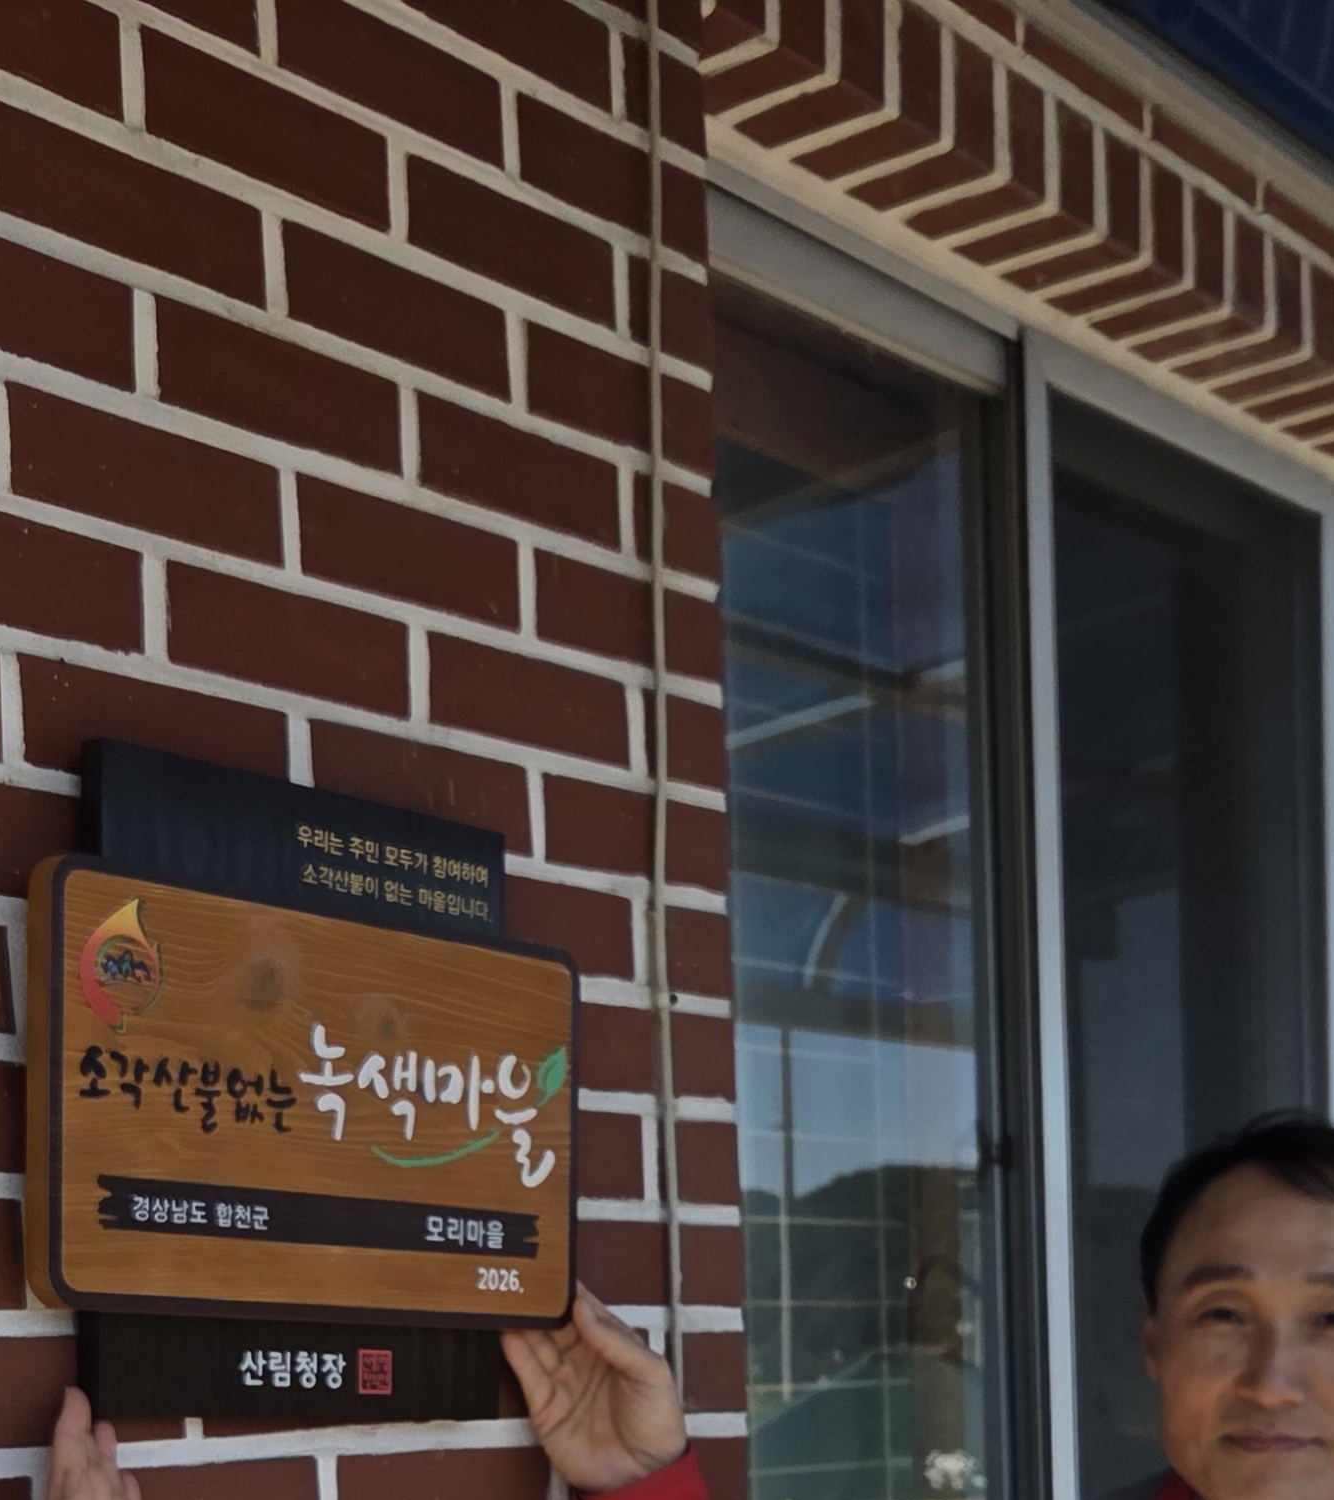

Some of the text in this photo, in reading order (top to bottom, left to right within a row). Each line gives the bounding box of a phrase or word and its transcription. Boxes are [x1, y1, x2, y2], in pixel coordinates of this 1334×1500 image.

[297, 825, 489, 888] 우리는 주민 모두가 참여하여
[302, 863, 493, 923] 소각산불이 없는 마을입니다.
[299, 1023, 556, 1187] 녹색마을
[132, 1196, 505, 1250] 경상남도 합천군 모리마을
[477, 1267, 525, 1294] 2026.
[239, 1349, 347, 1390] 산림청장
